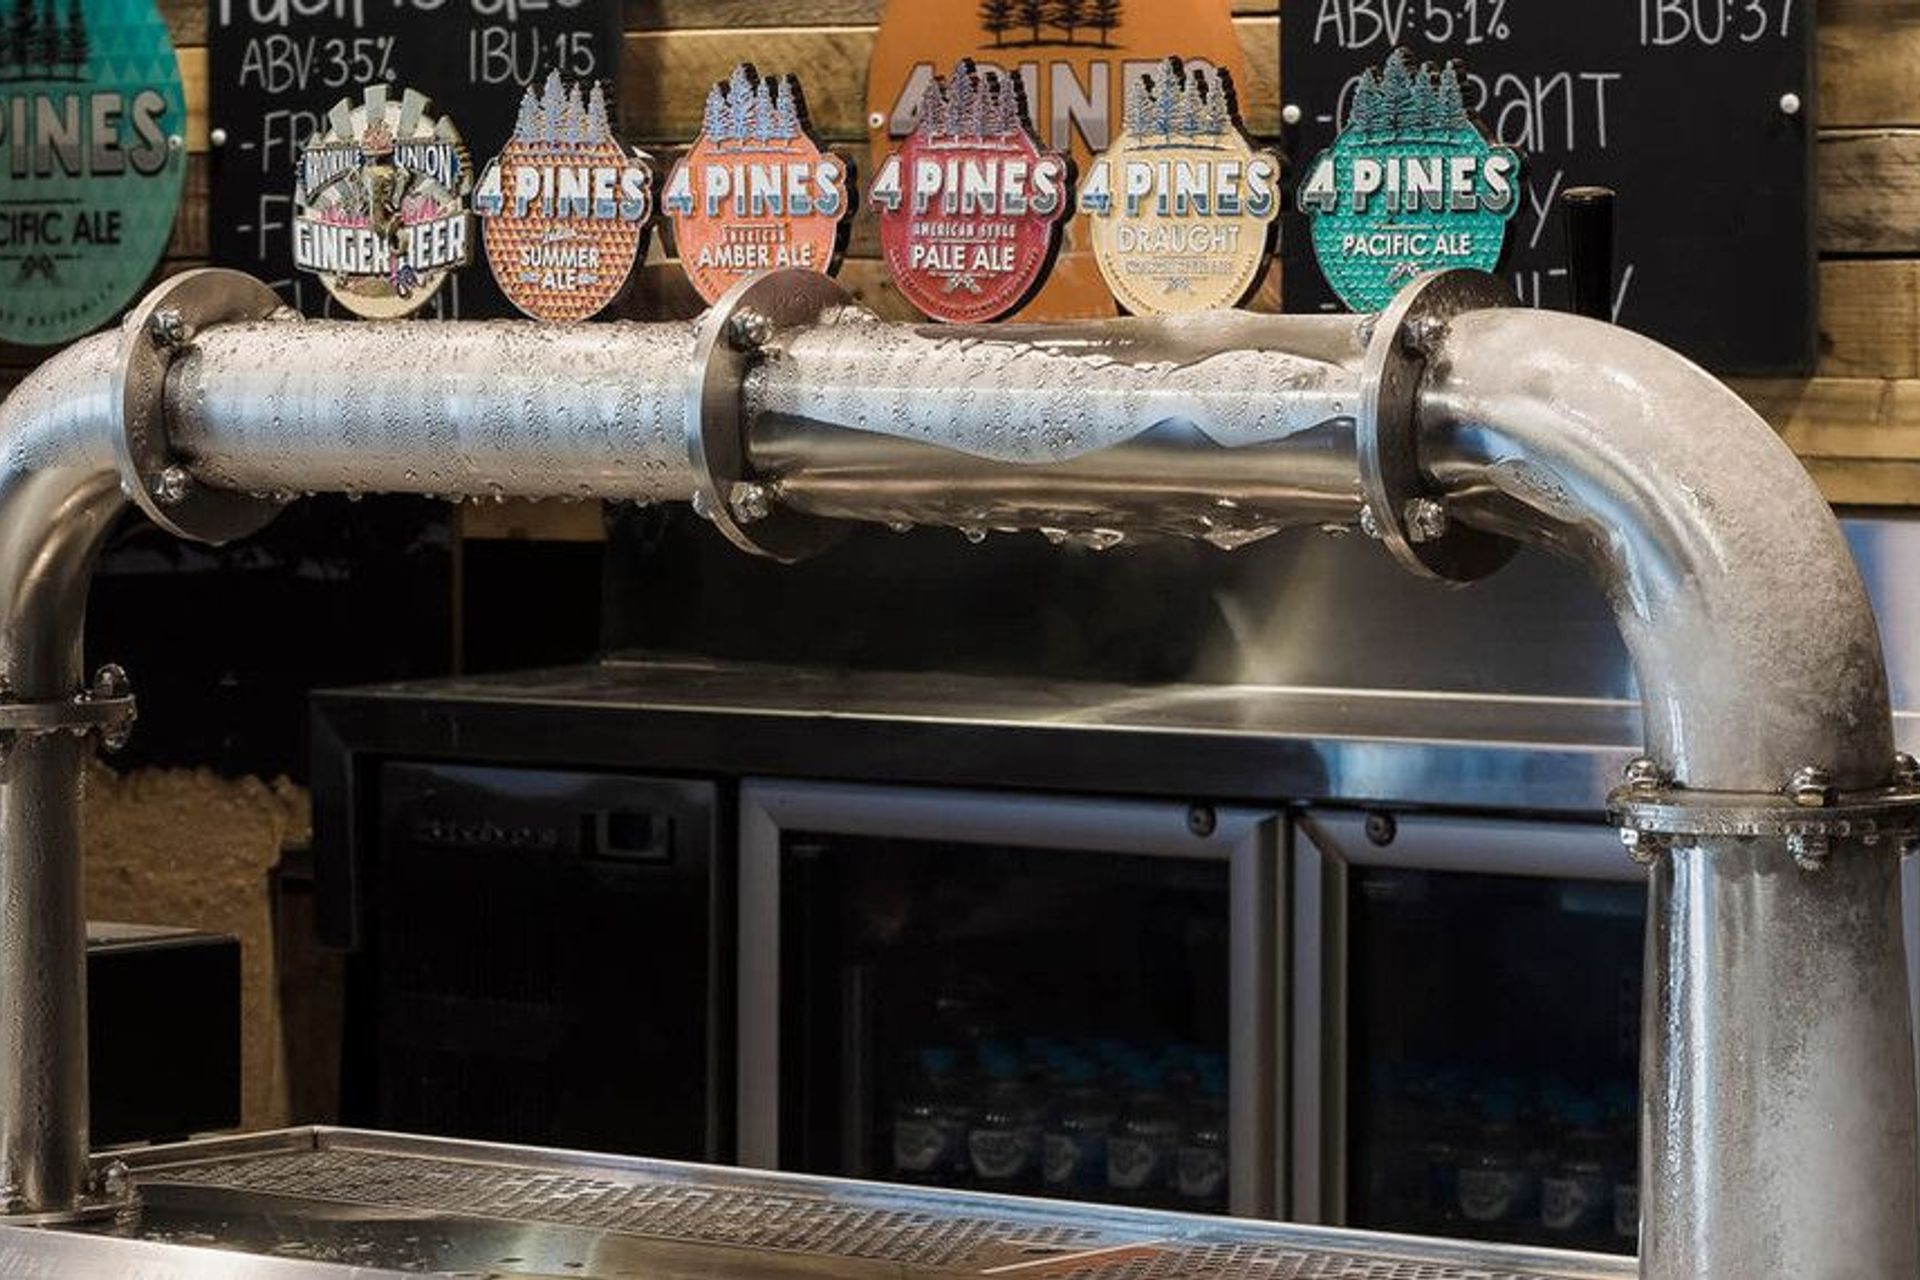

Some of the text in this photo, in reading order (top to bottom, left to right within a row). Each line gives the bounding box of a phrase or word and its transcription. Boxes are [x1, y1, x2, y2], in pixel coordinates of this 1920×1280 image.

[470, 26, 596, 86] IBU:15
[0, 89, 168, 179] INES
[477, 164, 645, 222] 4 PINES
[667, 161, 840, 217] 4 PINES
[872, 158, 1059, 215] 4 PINES
[1082, 160, 1274, 217] 4 PINES
[1303, 158, 1337, 214] 4
[1352, 156, 1512, 212] PINES
[71, 211, 121, 246] ALE
[1117, 224, 1240, 254] DRAUGHT
[1342, 233, 1472, 256] PACIFIC ALE
[520, 245, 600, 268] SUMMER
[698, 244, 812, 268] AMBER ALE
[910, 244, 1016, 271] PALE ALE
[541, 268, 577, 291] ALE
